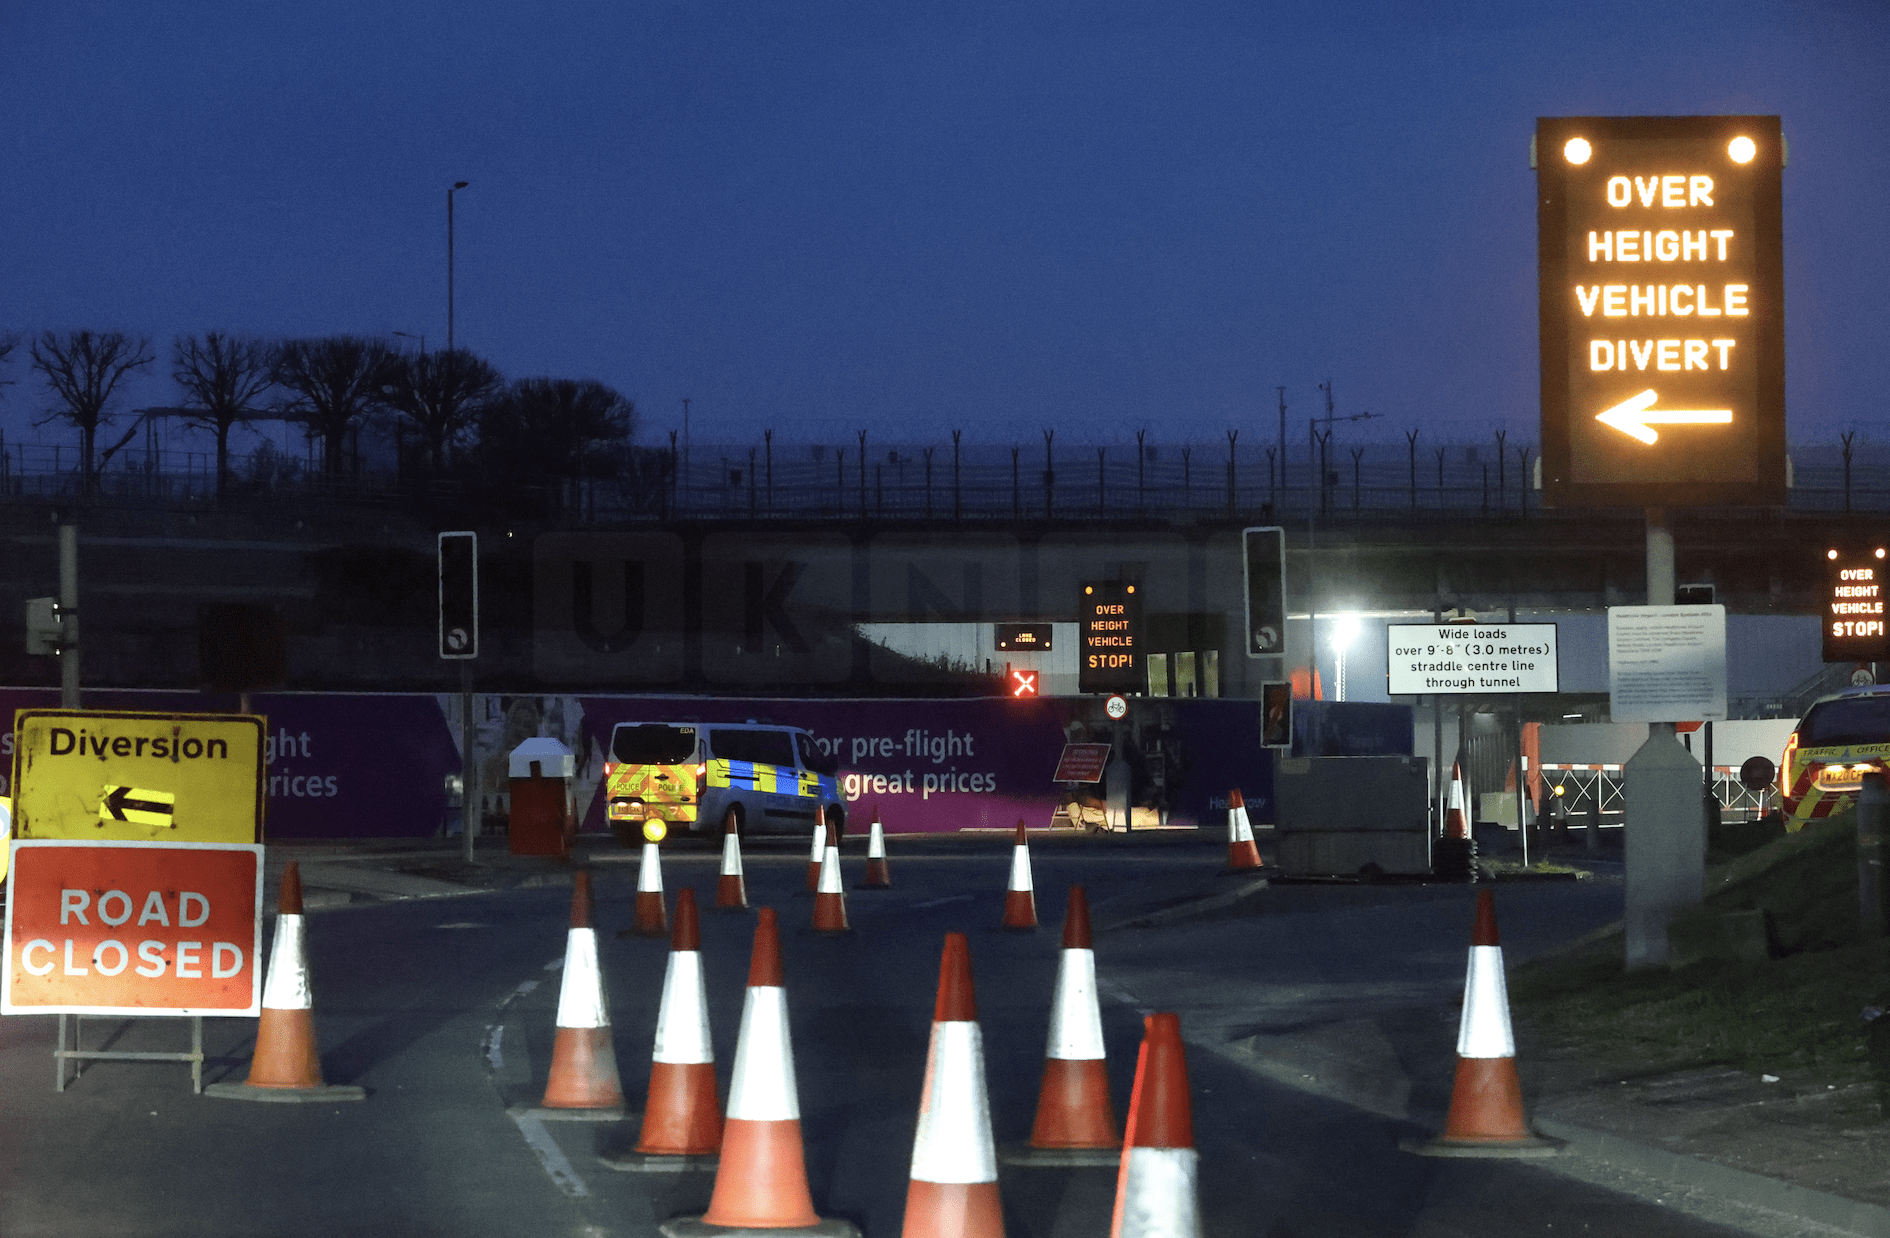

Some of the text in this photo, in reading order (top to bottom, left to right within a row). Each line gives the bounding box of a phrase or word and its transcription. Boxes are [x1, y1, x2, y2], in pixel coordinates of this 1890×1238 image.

[1606, 175, 1715, 208] OVER
[1588, 230, 1735, 262] HEIGHT
[1575, 284, 1750, 317] VEHICLE
[1590, 339, 1736, 371] DIVERT
[1840, 568, 1874, 581] OVER
[1834, 585, 1880, 598] HEIGHT
[1095, 605, 1125, 615] OVER
[1830, 601, 1884, 614] VEHICLE
[1090, 620, 1129, 631] HEIGHT
[1832, 620, 1884, 637] STOP!
[1438, 629, 1507, 639] Wide loads
[1087, 636, 1133, 647] VEHICLE
[1395, 646, 1422, 656] over
[1465, 643, 1494, 656] (3.0
[1499, 643, 1550, 656] metres)
[1088, 654, 1133, 668] STOP!
[1411, 660, 1535, 672] straddle centre line
[1426, 676, 1521, 689] through tunnel
[50, 728, 228, 760] Diversion
[852, 728, 975, 765] pre-flight
[1803, 747, 1838, 757] TRAFFIC
[268, 767, 338, 797] rices
[616, 783, 640, 791] POLICE
[845, 767, 997, 801] great prices
[60, 889, 211, 928] ROAD
[22, 939, 244, 979] CLOSED
